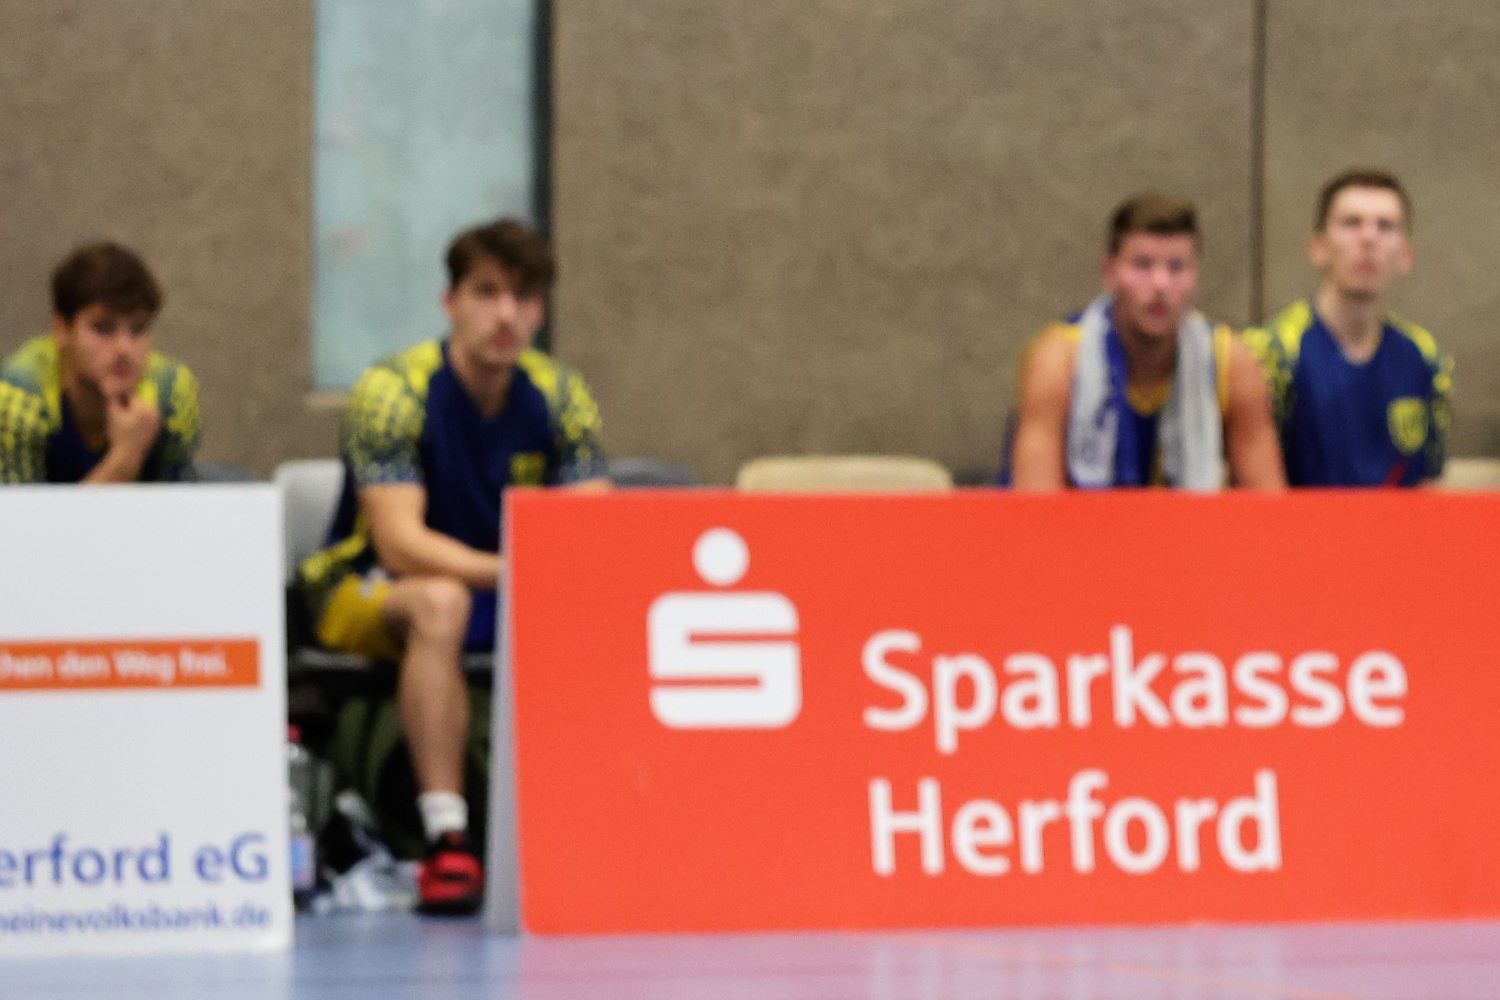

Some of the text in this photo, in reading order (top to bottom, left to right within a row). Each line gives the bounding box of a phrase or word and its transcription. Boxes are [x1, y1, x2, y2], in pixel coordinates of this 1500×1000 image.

[57, 650, 110, 678] den
[112, 650, 176, 684] Weg
[862, 626, 1408, 753] Sparkasse
[193, 831, 270, 883] eG
[868, 770, 1282, 877] Herford
